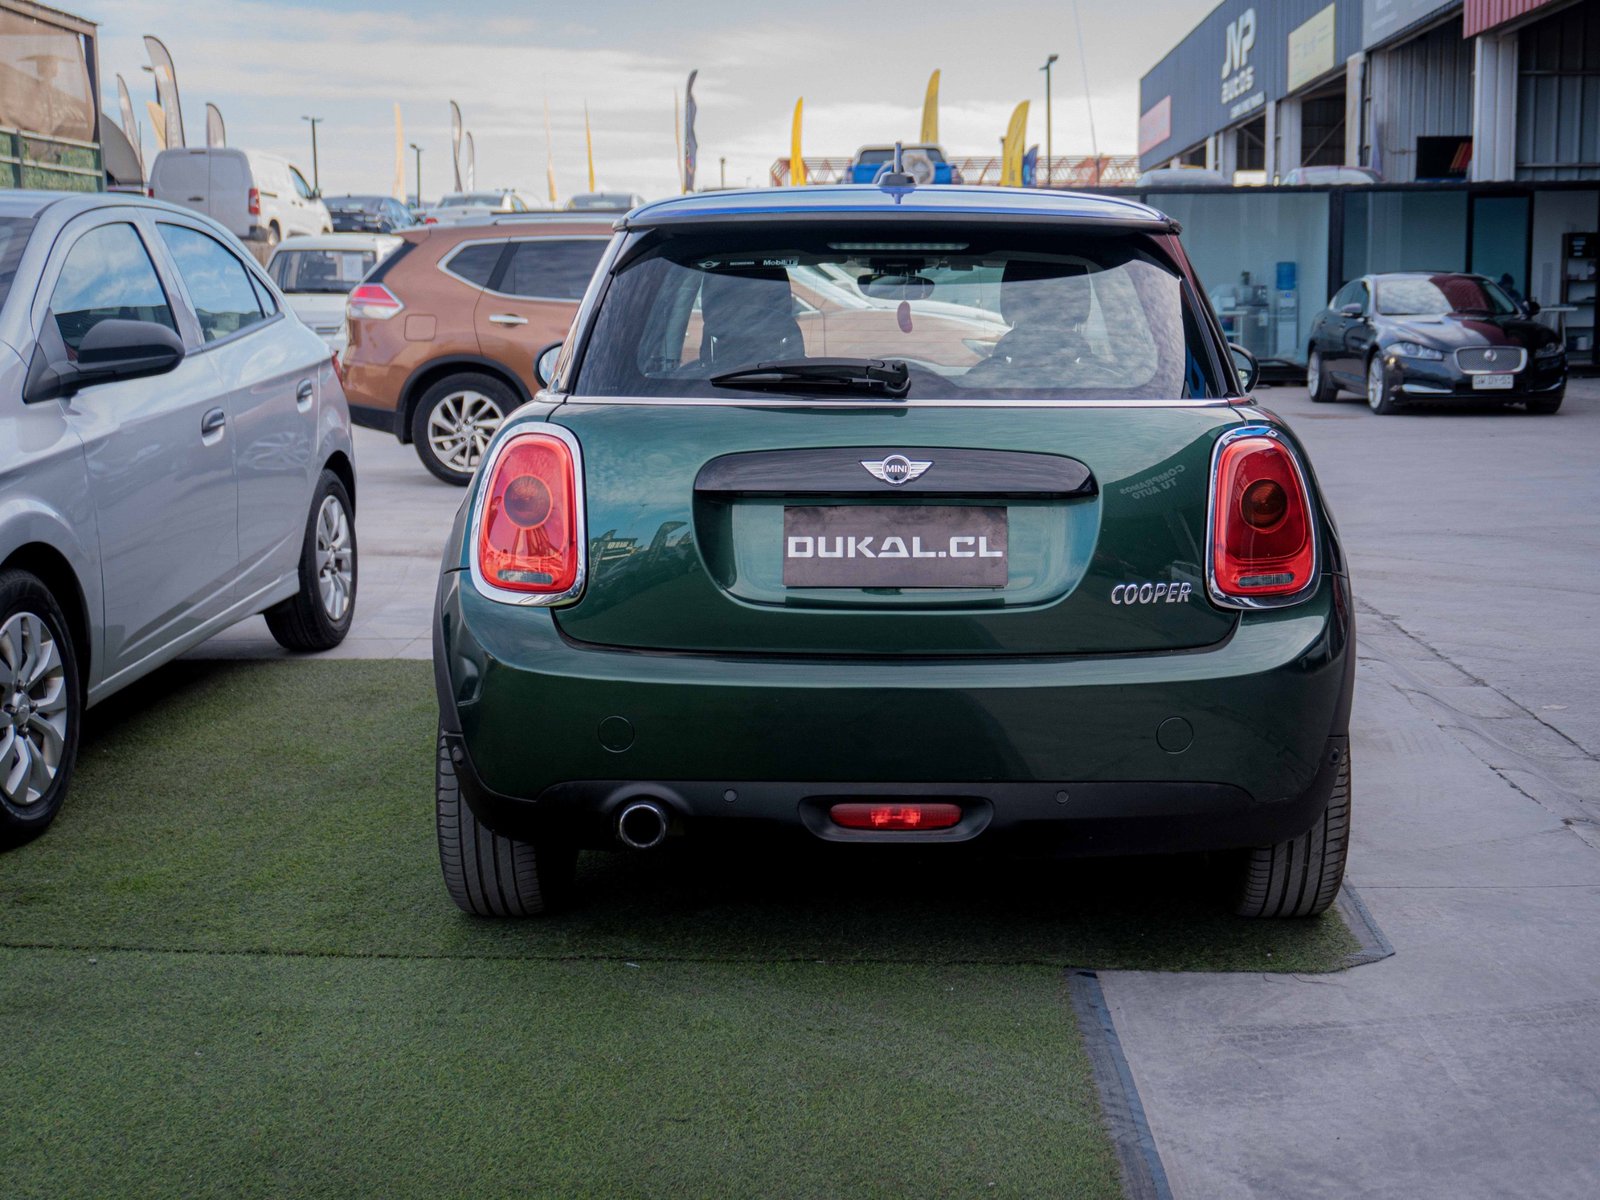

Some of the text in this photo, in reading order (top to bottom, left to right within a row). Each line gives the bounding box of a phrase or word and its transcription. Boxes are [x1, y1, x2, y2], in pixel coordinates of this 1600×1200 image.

[886, 464, 908, 473] MINI
[787, 536, 1004, 558] DUKAL.CL
[1110, 582, 1192, 605] COOPER
